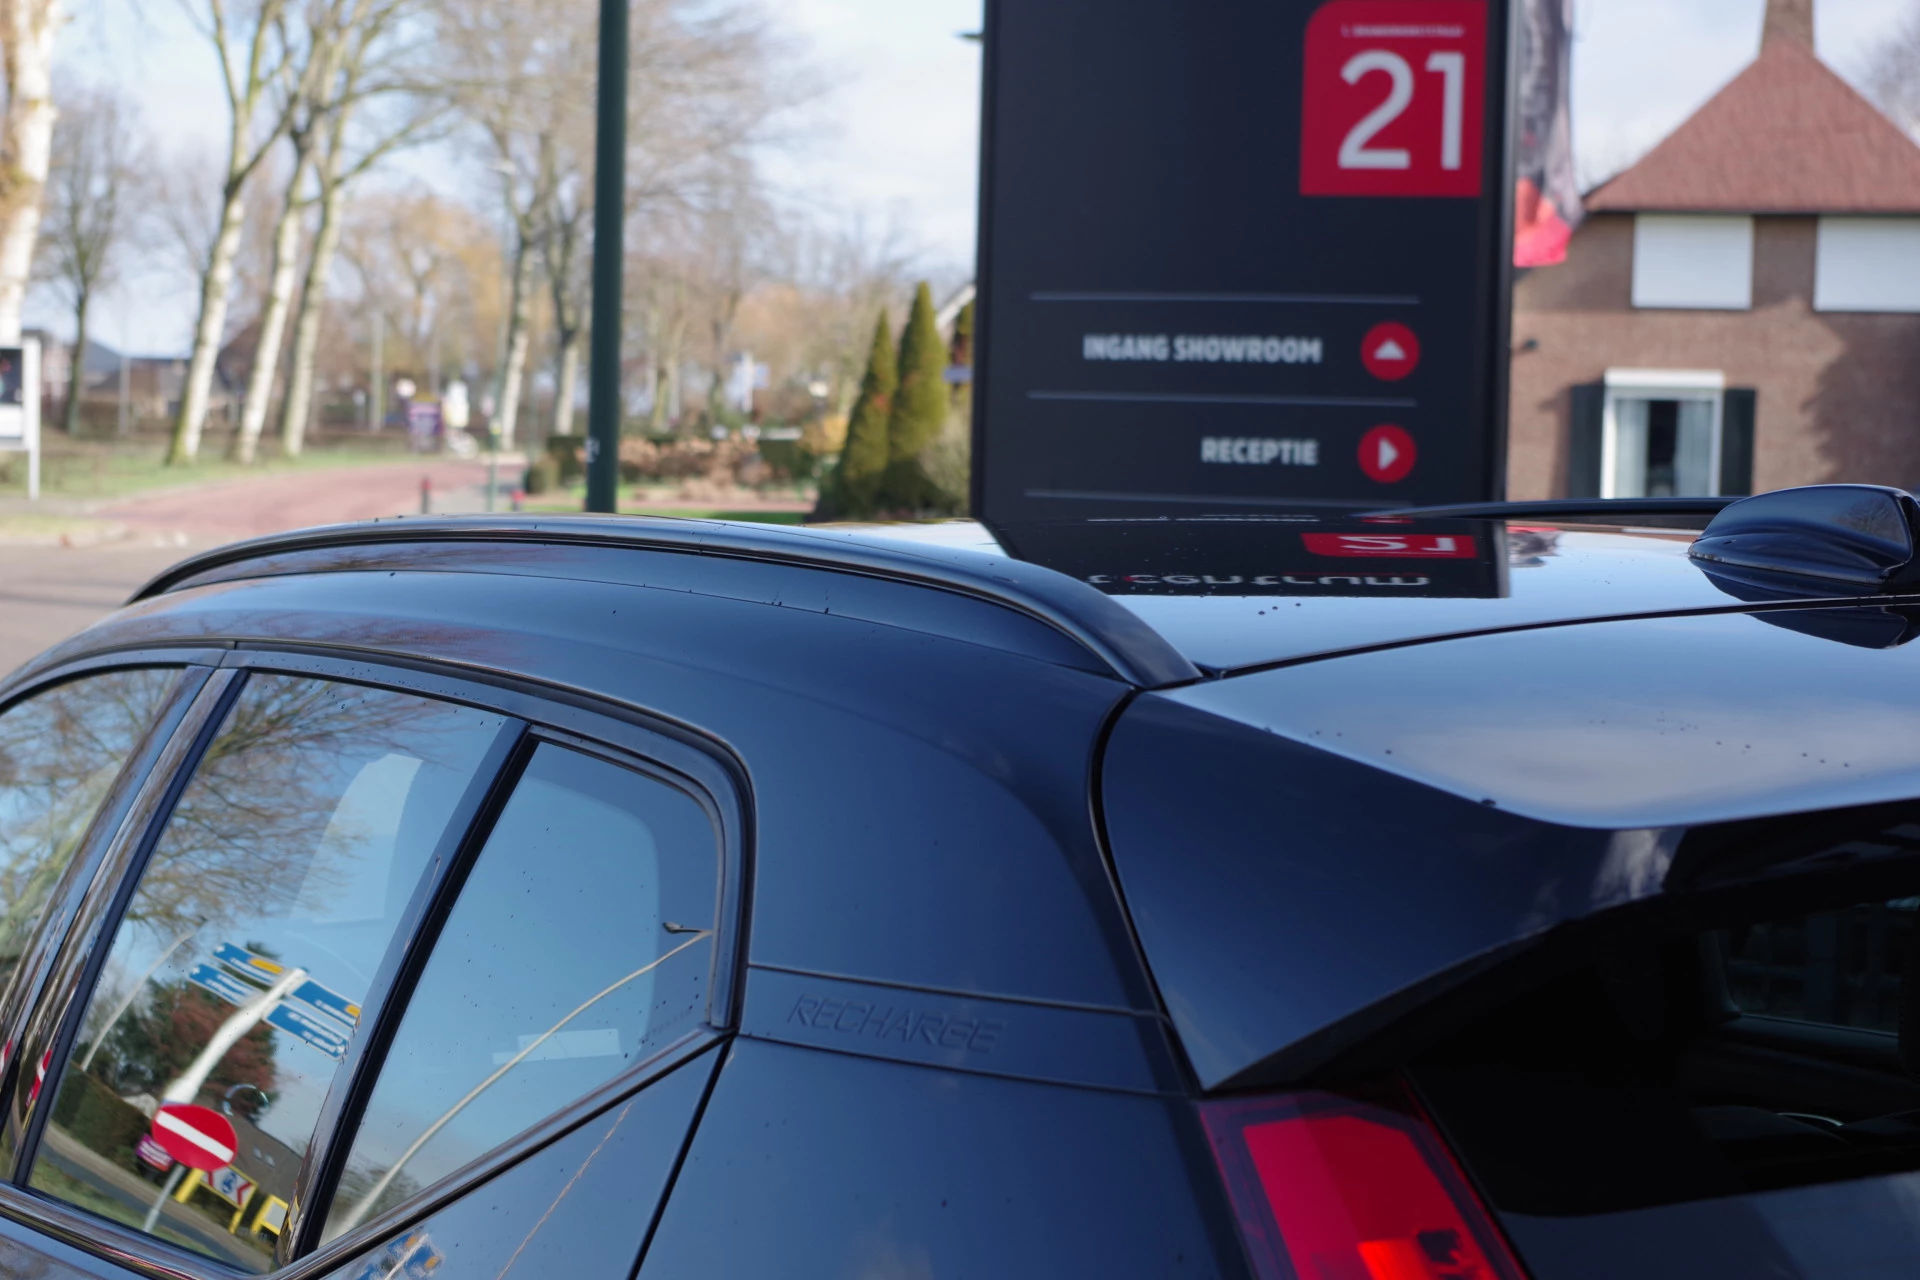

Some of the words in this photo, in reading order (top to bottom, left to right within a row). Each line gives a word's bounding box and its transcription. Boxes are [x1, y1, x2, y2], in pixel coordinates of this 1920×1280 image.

[1338, 49, 1465, 170] 21
[1083, 334, 1169, 361] INGANG
[1172, 335, 1323, 363] SHOWROOM
[1201, 437, 1319, 465] RECEPTIE
[786, 993, 1005, 1053] RECHARGE
